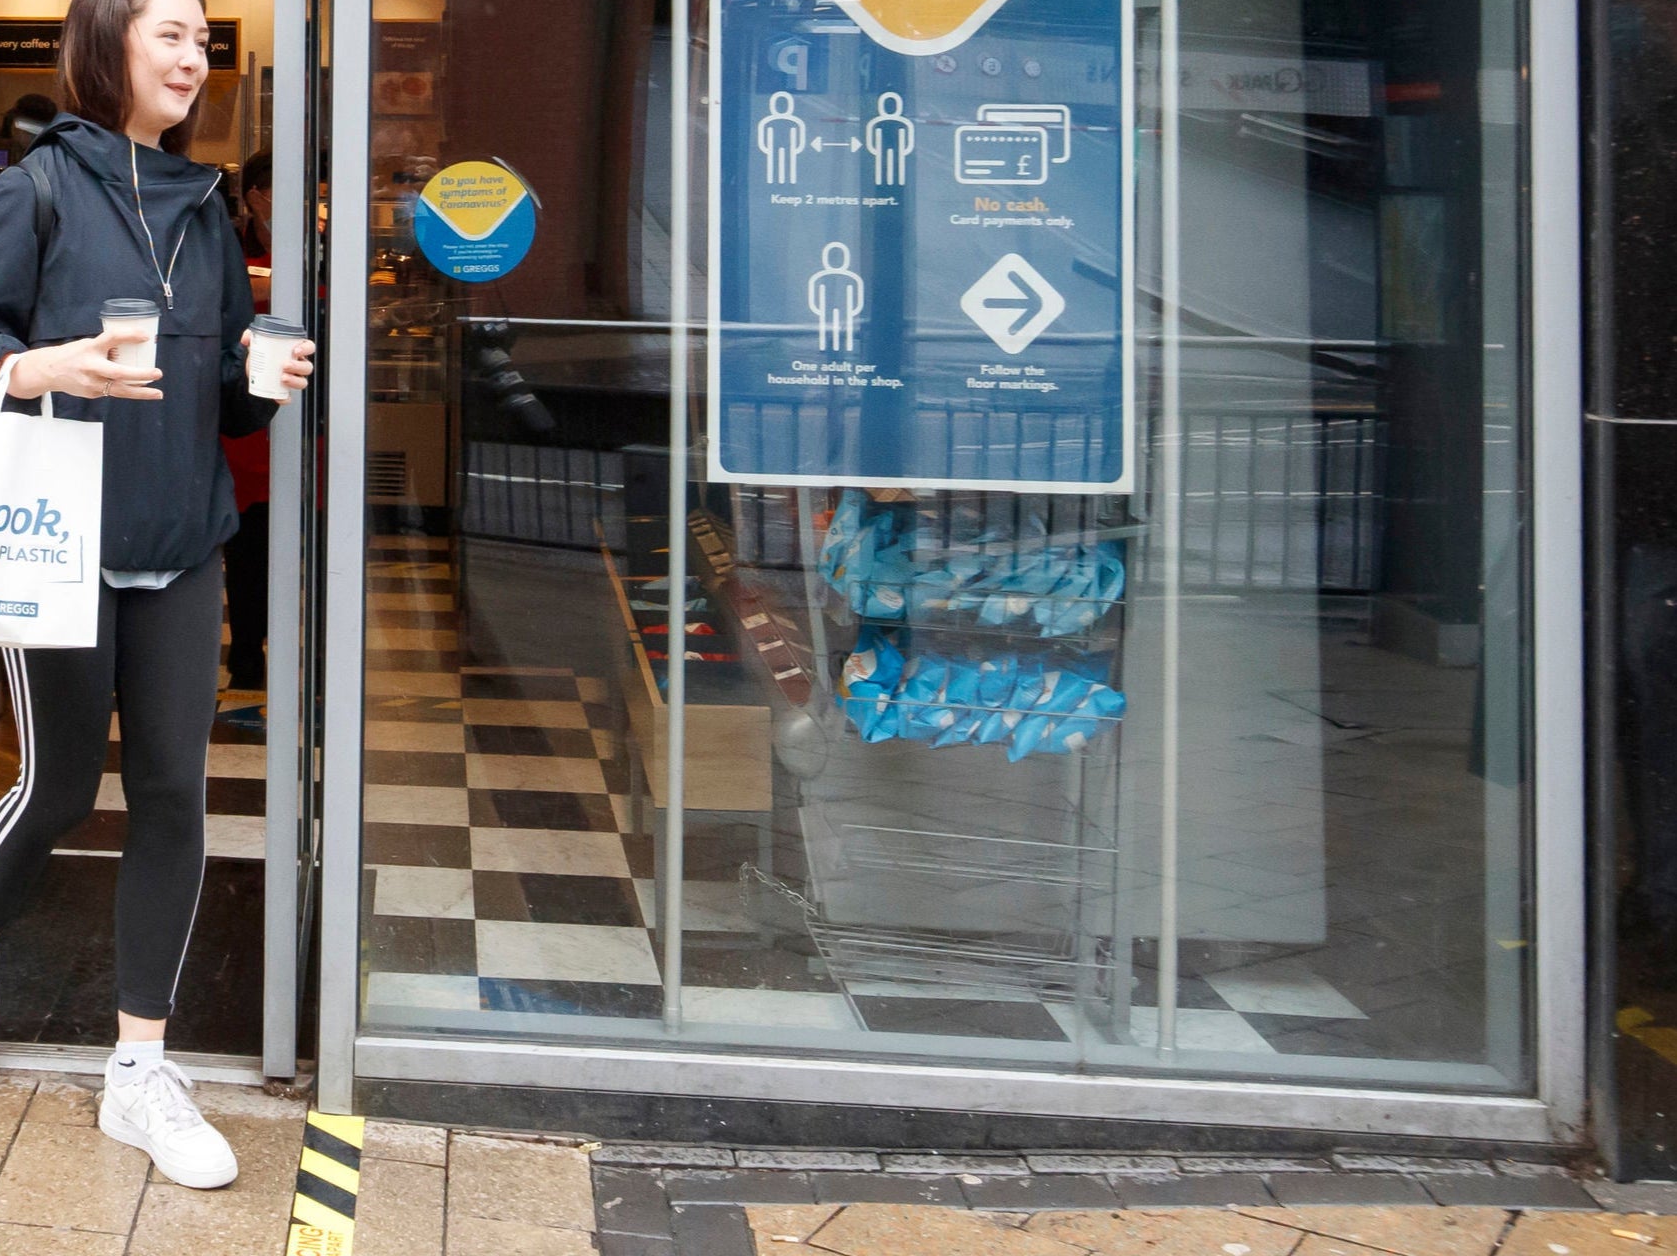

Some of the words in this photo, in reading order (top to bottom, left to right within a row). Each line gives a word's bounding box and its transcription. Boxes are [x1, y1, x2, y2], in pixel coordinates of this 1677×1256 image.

[21, 38, 51, 49] coffee
[211, 43, 228, 52] you
[771, 195, 802, 207] Keep
[805, 195, 814, 205] 2
[817, 196, 859, 205] metres
[863, 196, 899, 207] apart.
[974, 197, 1001, 212] No
[1006, 197, 1050, 212] cash.
[950, 214, 980, 225] Card
[983, 217, 1043, 228] payments
[1045, 216, 1075, 229] only.
[463, 264, 500, 273] GREGGS
[792, 361, 818, 371] One
[821, 361, 852, 372] adult
[855, 364, 876, 374] per
[980, 364, 1021, 376] Follow
[1024, 365, 1045, 376] the
[768, 373, 830, 385] household
[833, 375, 844, 385] in
[848, 375, 867, 386] the
[871, 376, 904, 389] shop.
[966, 377, 997, 388] floor
[999, 379, 1059, 392] markings.
